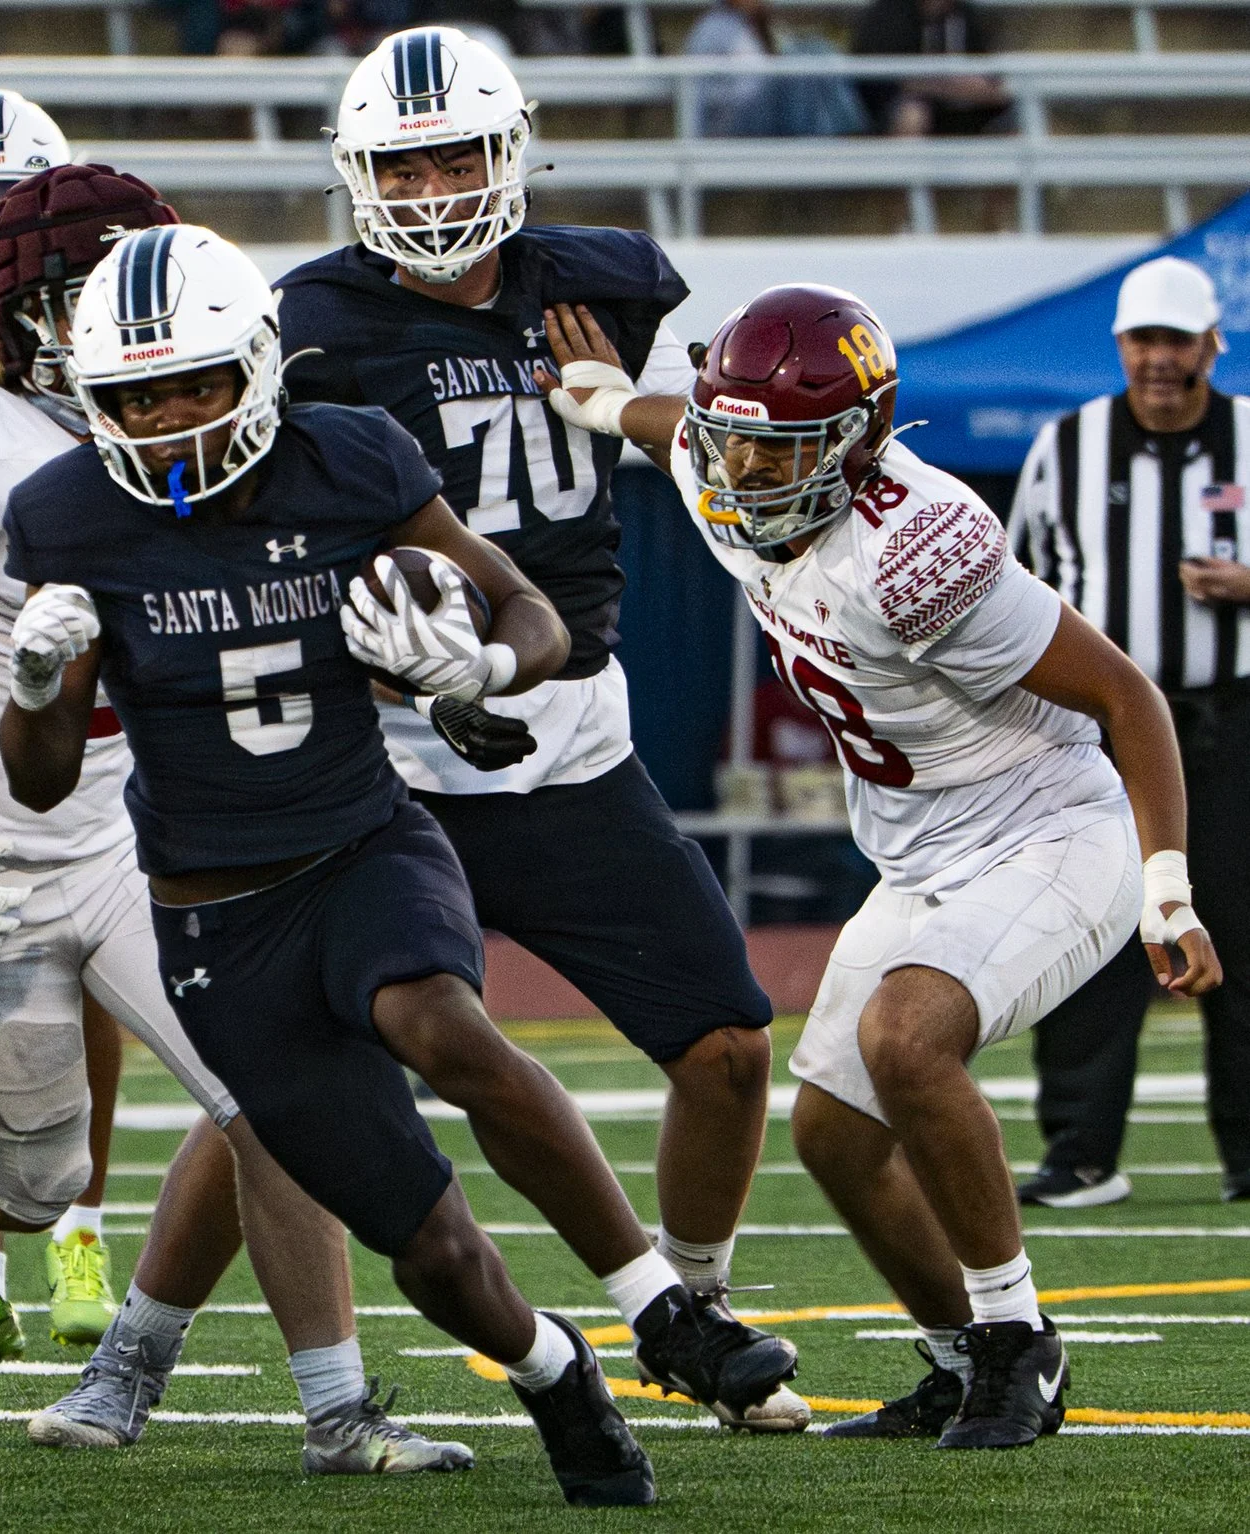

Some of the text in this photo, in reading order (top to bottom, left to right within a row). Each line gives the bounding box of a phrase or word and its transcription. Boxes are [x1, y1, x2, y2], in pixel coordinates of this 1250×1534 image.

[427, 356, 513, 400] SANTA
[837, 324, 886, 392] 18
[716, 400, 759, 417] Riddell
[438, 394, 597, 535] 70
[852, 475, 908, 529] 18
[143, 569, 344, 635] SANTA MONICA
[218, 639, 314, 757] 5
